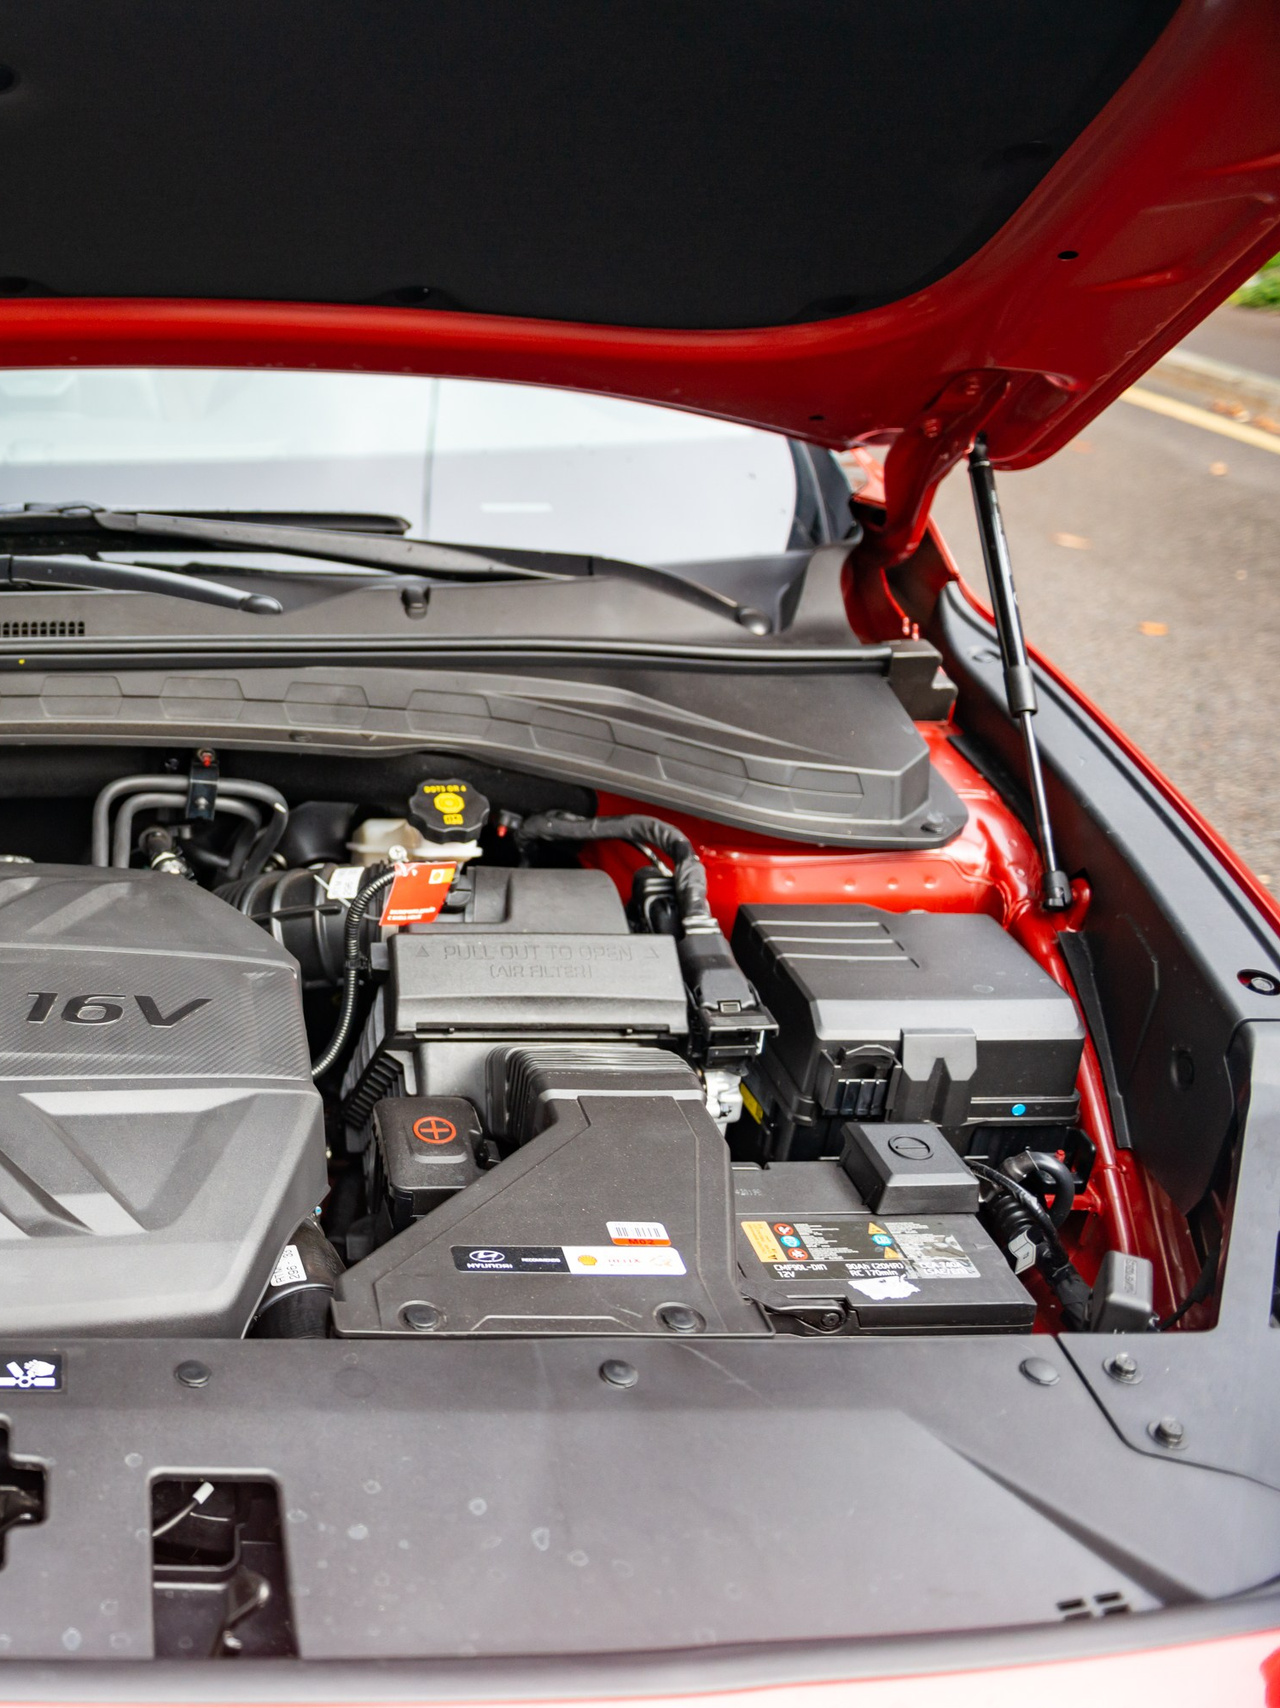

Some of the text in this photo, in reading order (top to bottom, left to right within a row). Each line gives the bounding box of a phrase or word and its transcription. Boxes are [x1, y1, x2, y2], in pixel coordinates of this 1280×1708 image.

[443, 944, 633, 961] PULL OUT TO OPEN
[490, 963, 592, 979] (AIR FILTER)
[26, 991, 213, 1028] 16V
[850, 1269, 899, 1277] RC 170min
[872, 1262, 904, 1270] (20HR)
